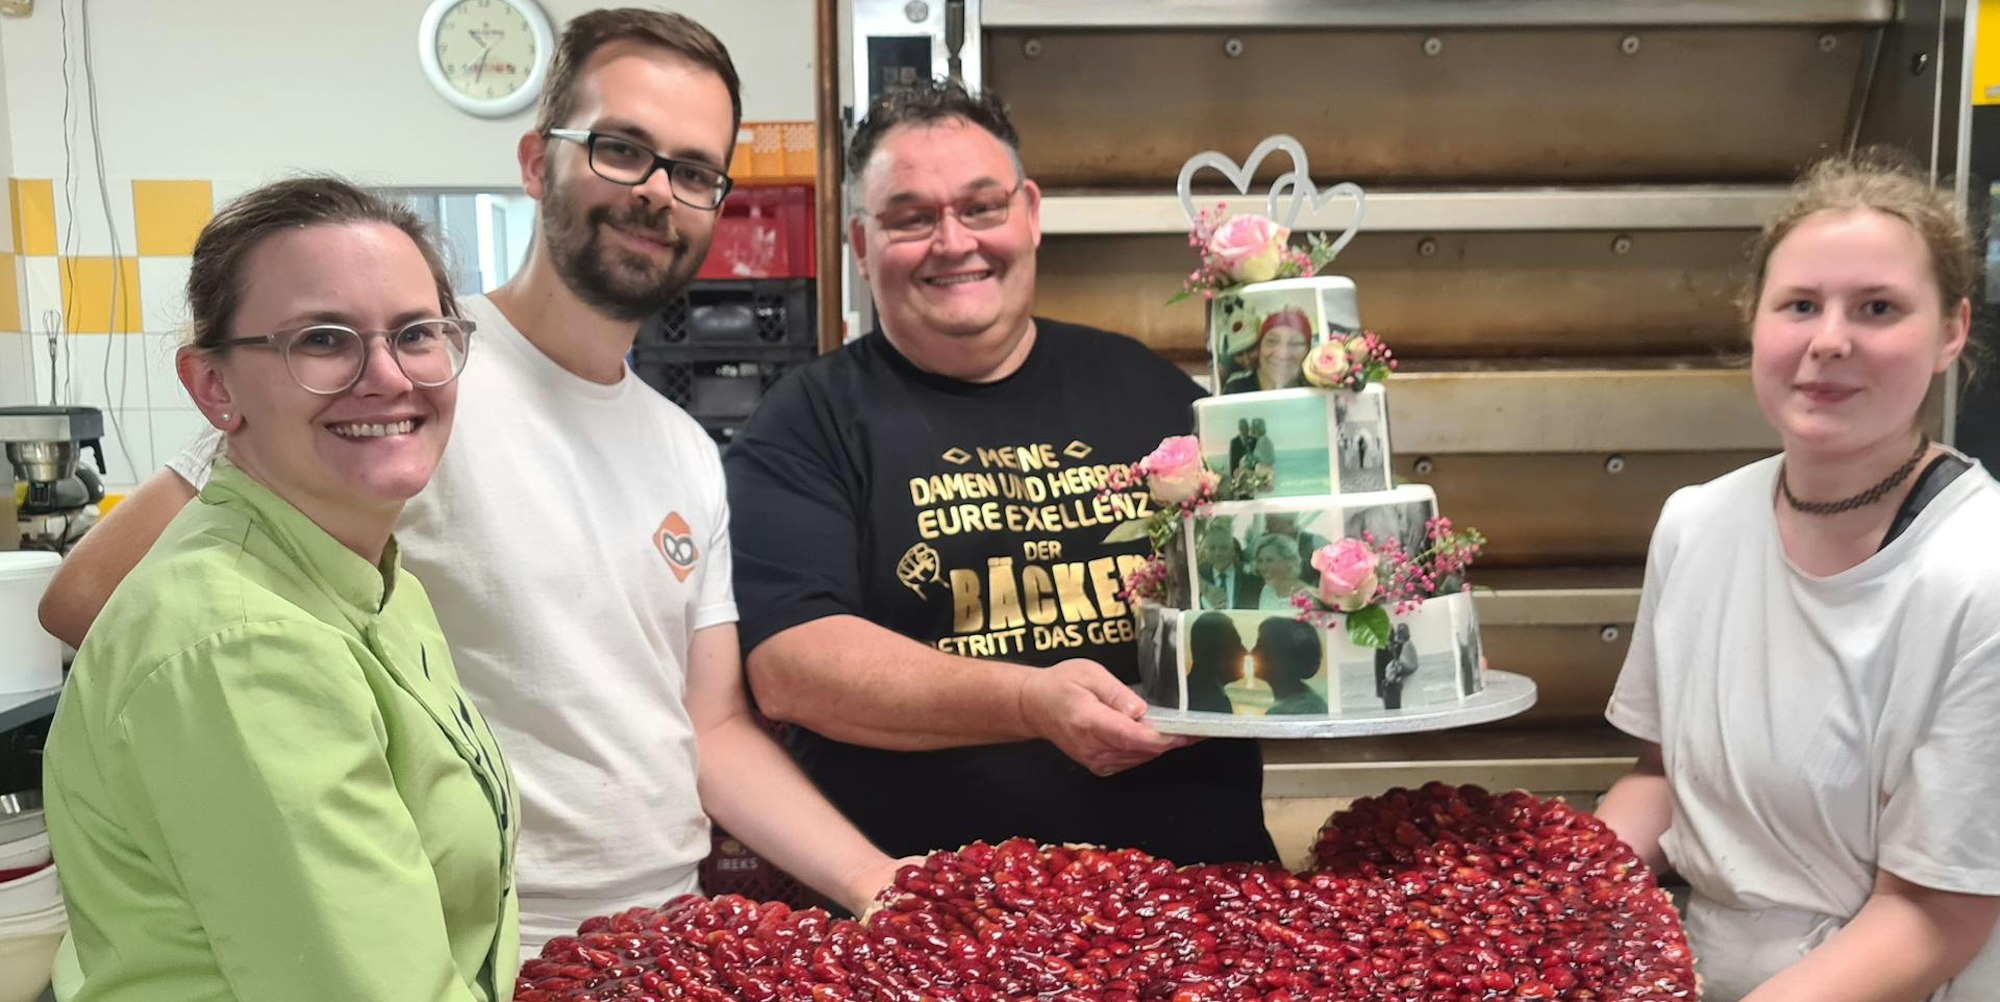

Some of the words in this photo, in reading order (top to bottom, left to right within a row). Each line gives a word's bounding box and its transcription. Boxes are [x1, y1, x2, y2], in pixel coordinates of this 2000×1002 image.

[909, 472, 998, 507] DAMEN
[998, 472, 1047, 503] UND
[917, 502, 1003, 539] EURE
[1004, 491, 1155, 533] EXELLENZ
[1023, 540, 1063, 561] DER
[929, 627, 1026, 657] ETRITT
[1033, 624, 1084, 651] DAS
